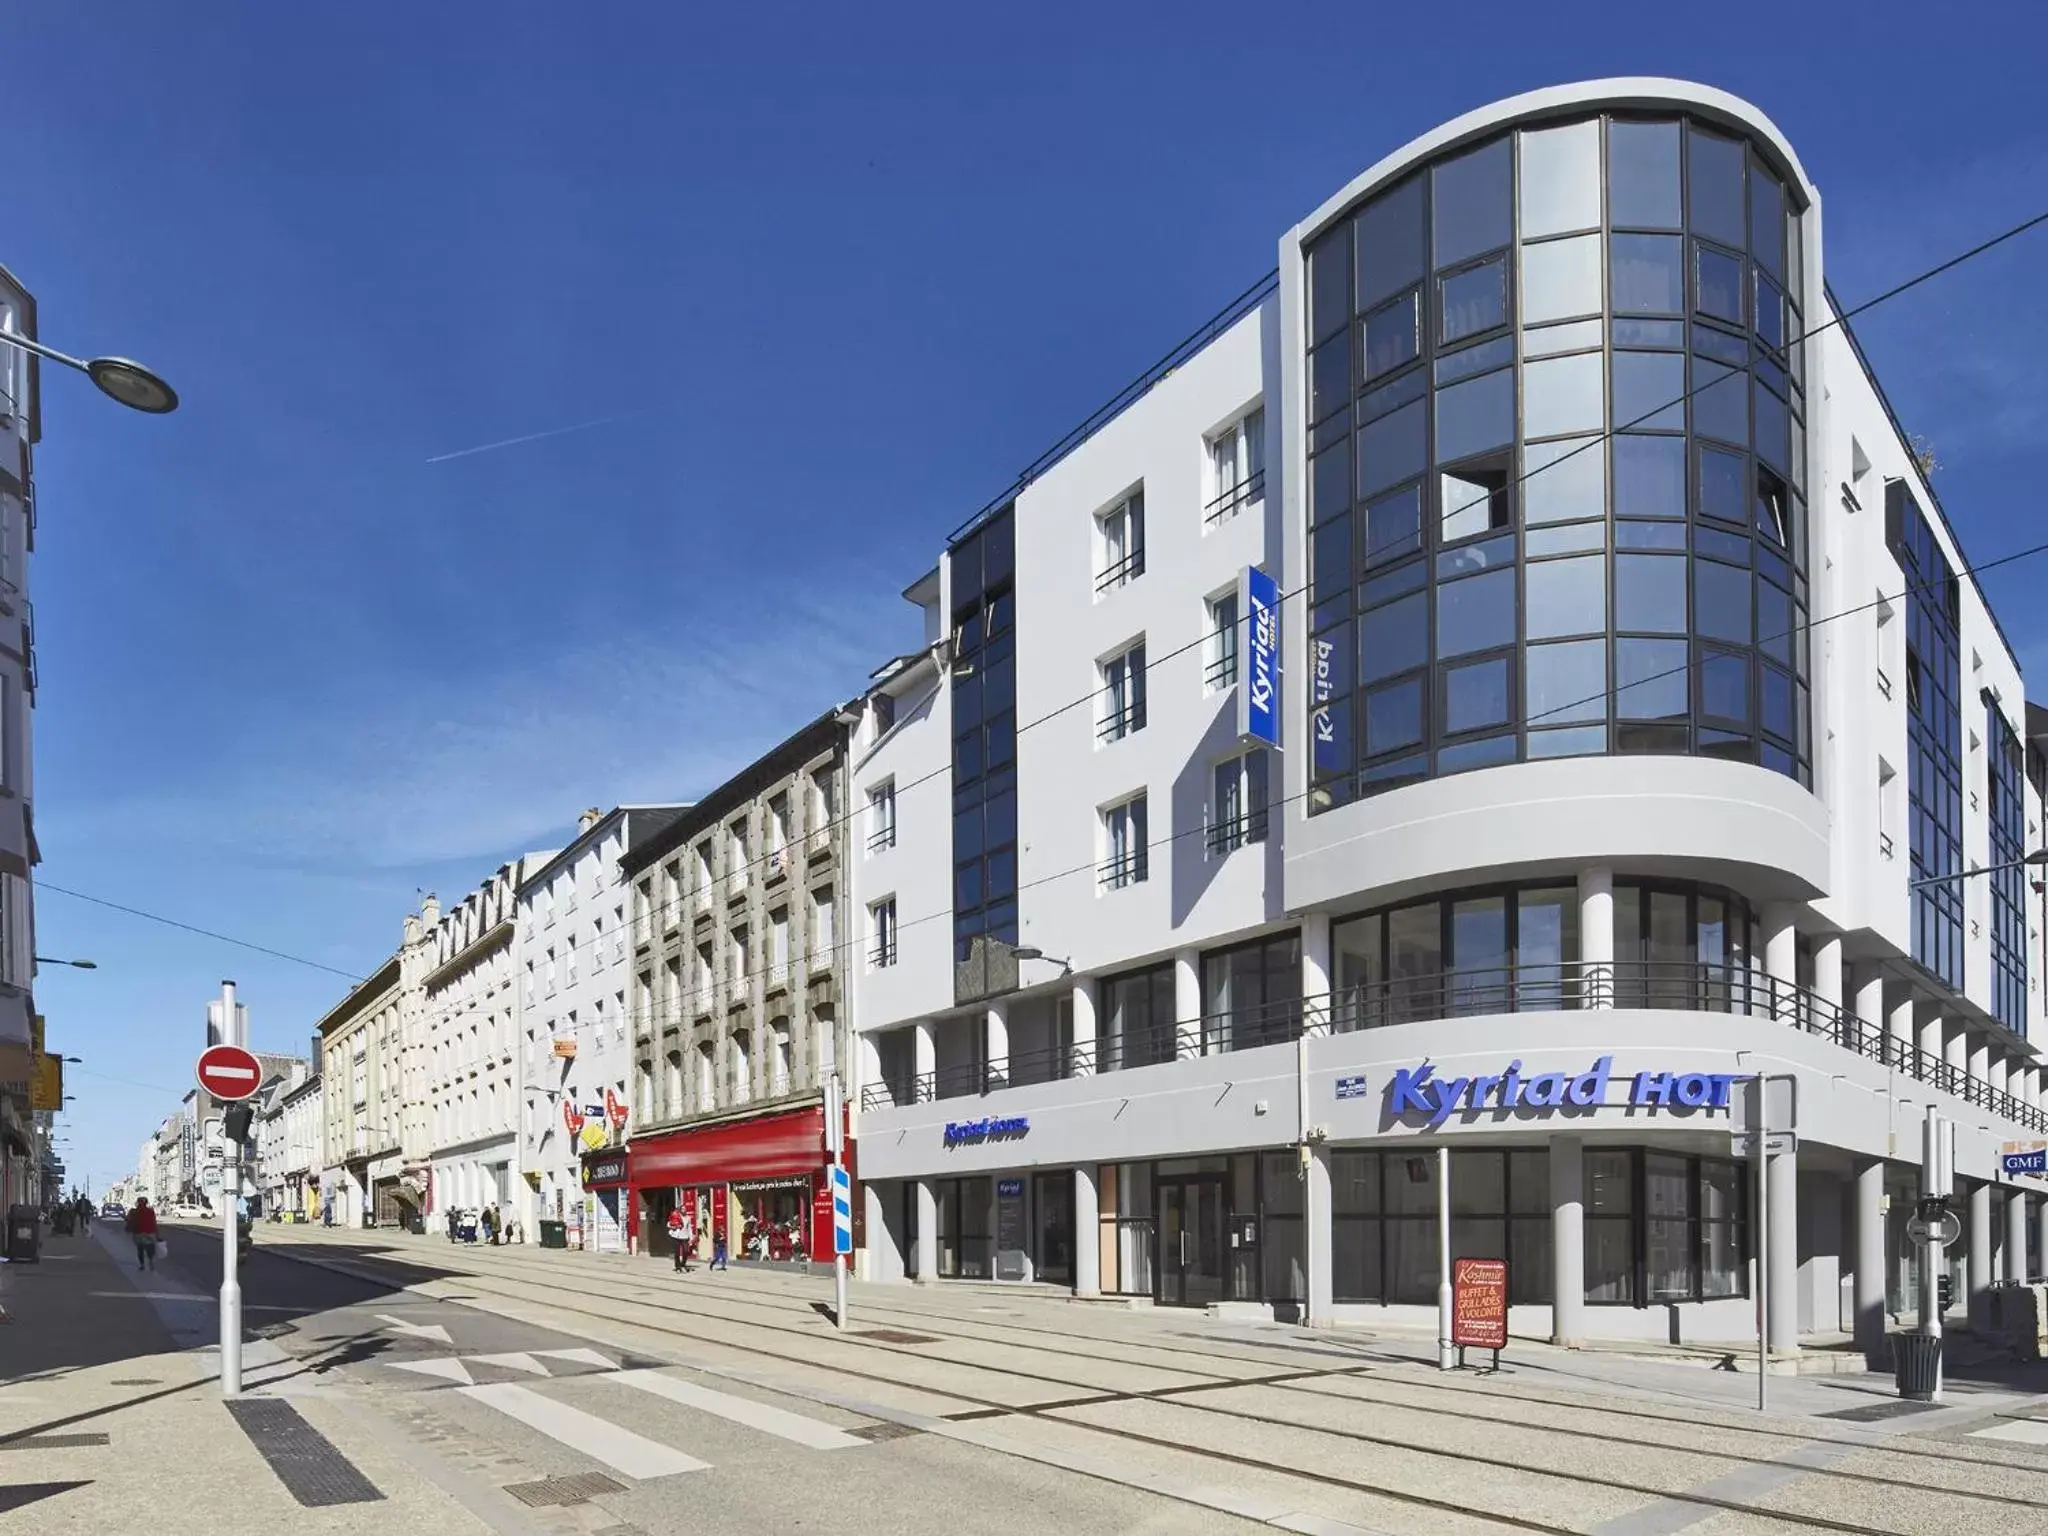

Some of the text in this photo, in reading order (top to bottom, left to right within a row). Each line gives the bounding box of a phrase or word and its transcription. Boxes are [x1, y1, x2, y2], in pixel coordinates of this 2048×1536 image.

[1252, 595, 1273, 714] Kyriad
[1391, 1055, 1613, 1125] Kyriad
[2006, 1156, 2043, 1169] GMF
[1459, 1286, 1497, 1298] BUFFET &
[1458, 1296, 1501, 1309] GRILLADES
